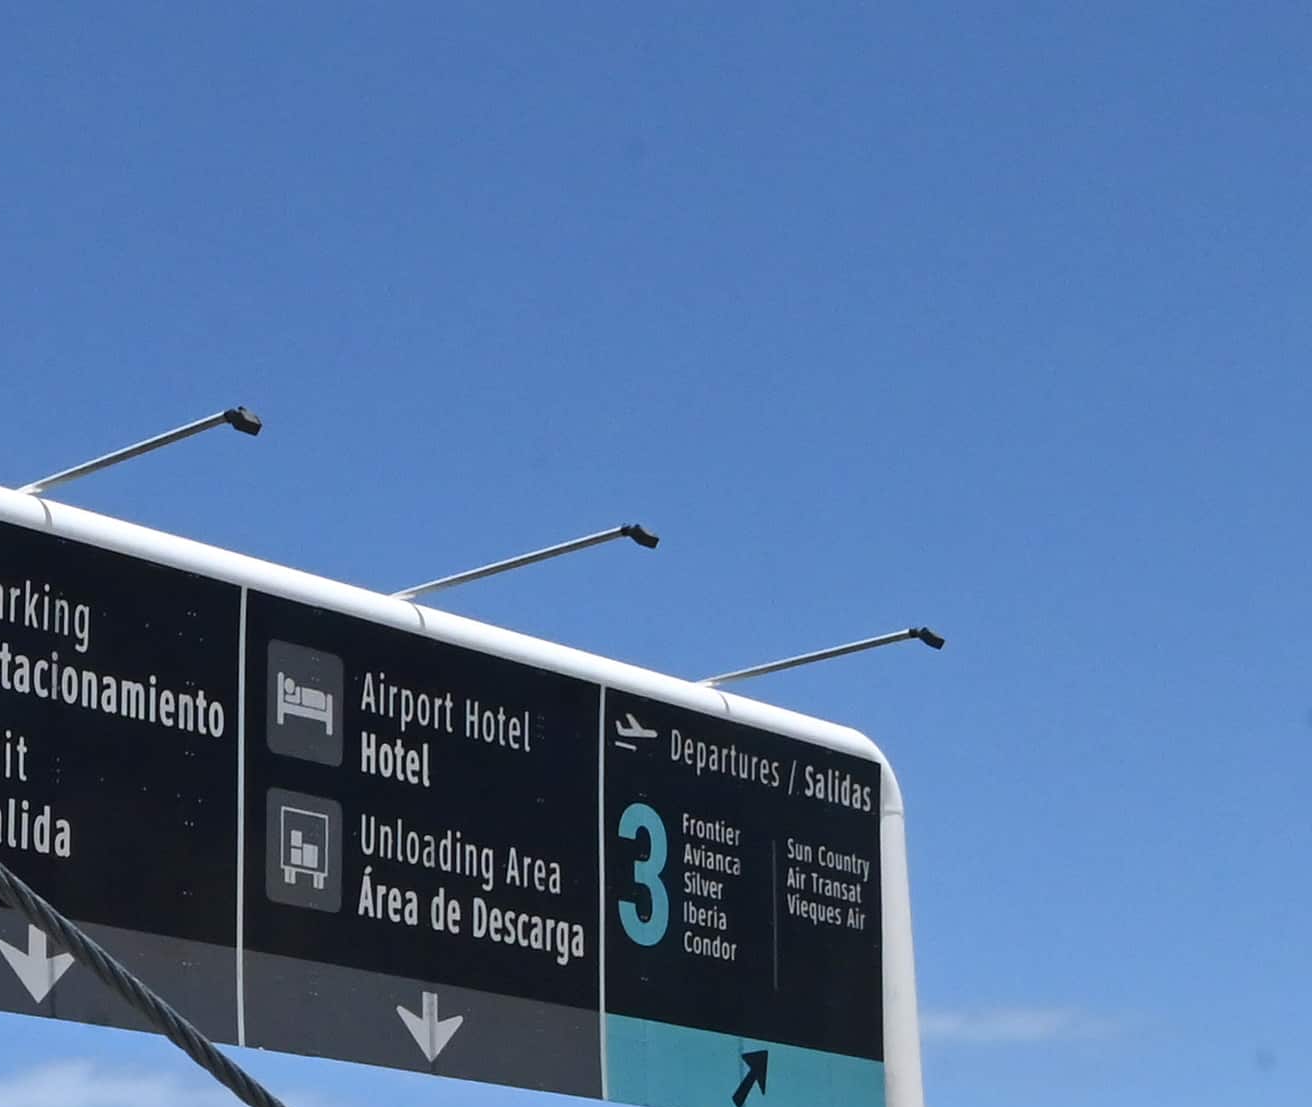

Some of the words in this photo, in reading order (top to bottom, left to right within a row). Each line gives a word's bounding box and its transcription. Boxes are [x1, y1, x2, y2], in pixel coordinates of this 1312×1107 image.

[361, 672, 453, 733] Airport
[465, 699, 531, 753] Hotel
[361, 733, 430, 787] Hotel
[671, 729, 780, 787] Departures
[788, 760, 797, 795] /
[804, 765, 871, 812] Salidas
[682, 812, 741, 846] Frontier
[361, 813, 494, 892] Unloading
[506, 847, 561, 894] Area
[618, 803, 669, 946] 3
[683, 843, 741, 876] Avianca
[787, 837, 813, 863] Sun
[818, 845, 870, 883] Country
[683, 871, 724, 900] Silver
[786, 866, 807, 890] Air
[810, 872, 862, 904] Transat
[357, 866, 418, 926] Área
[430, 887, 461, 934] de
[472, 897, 585, 965] Descarga
[683, 901, 727, 931] Iberia
[786, 893, 842, 926] Vieques
[846, 907, 866, 930] Air
[683, 930, 737, 961] Condor
